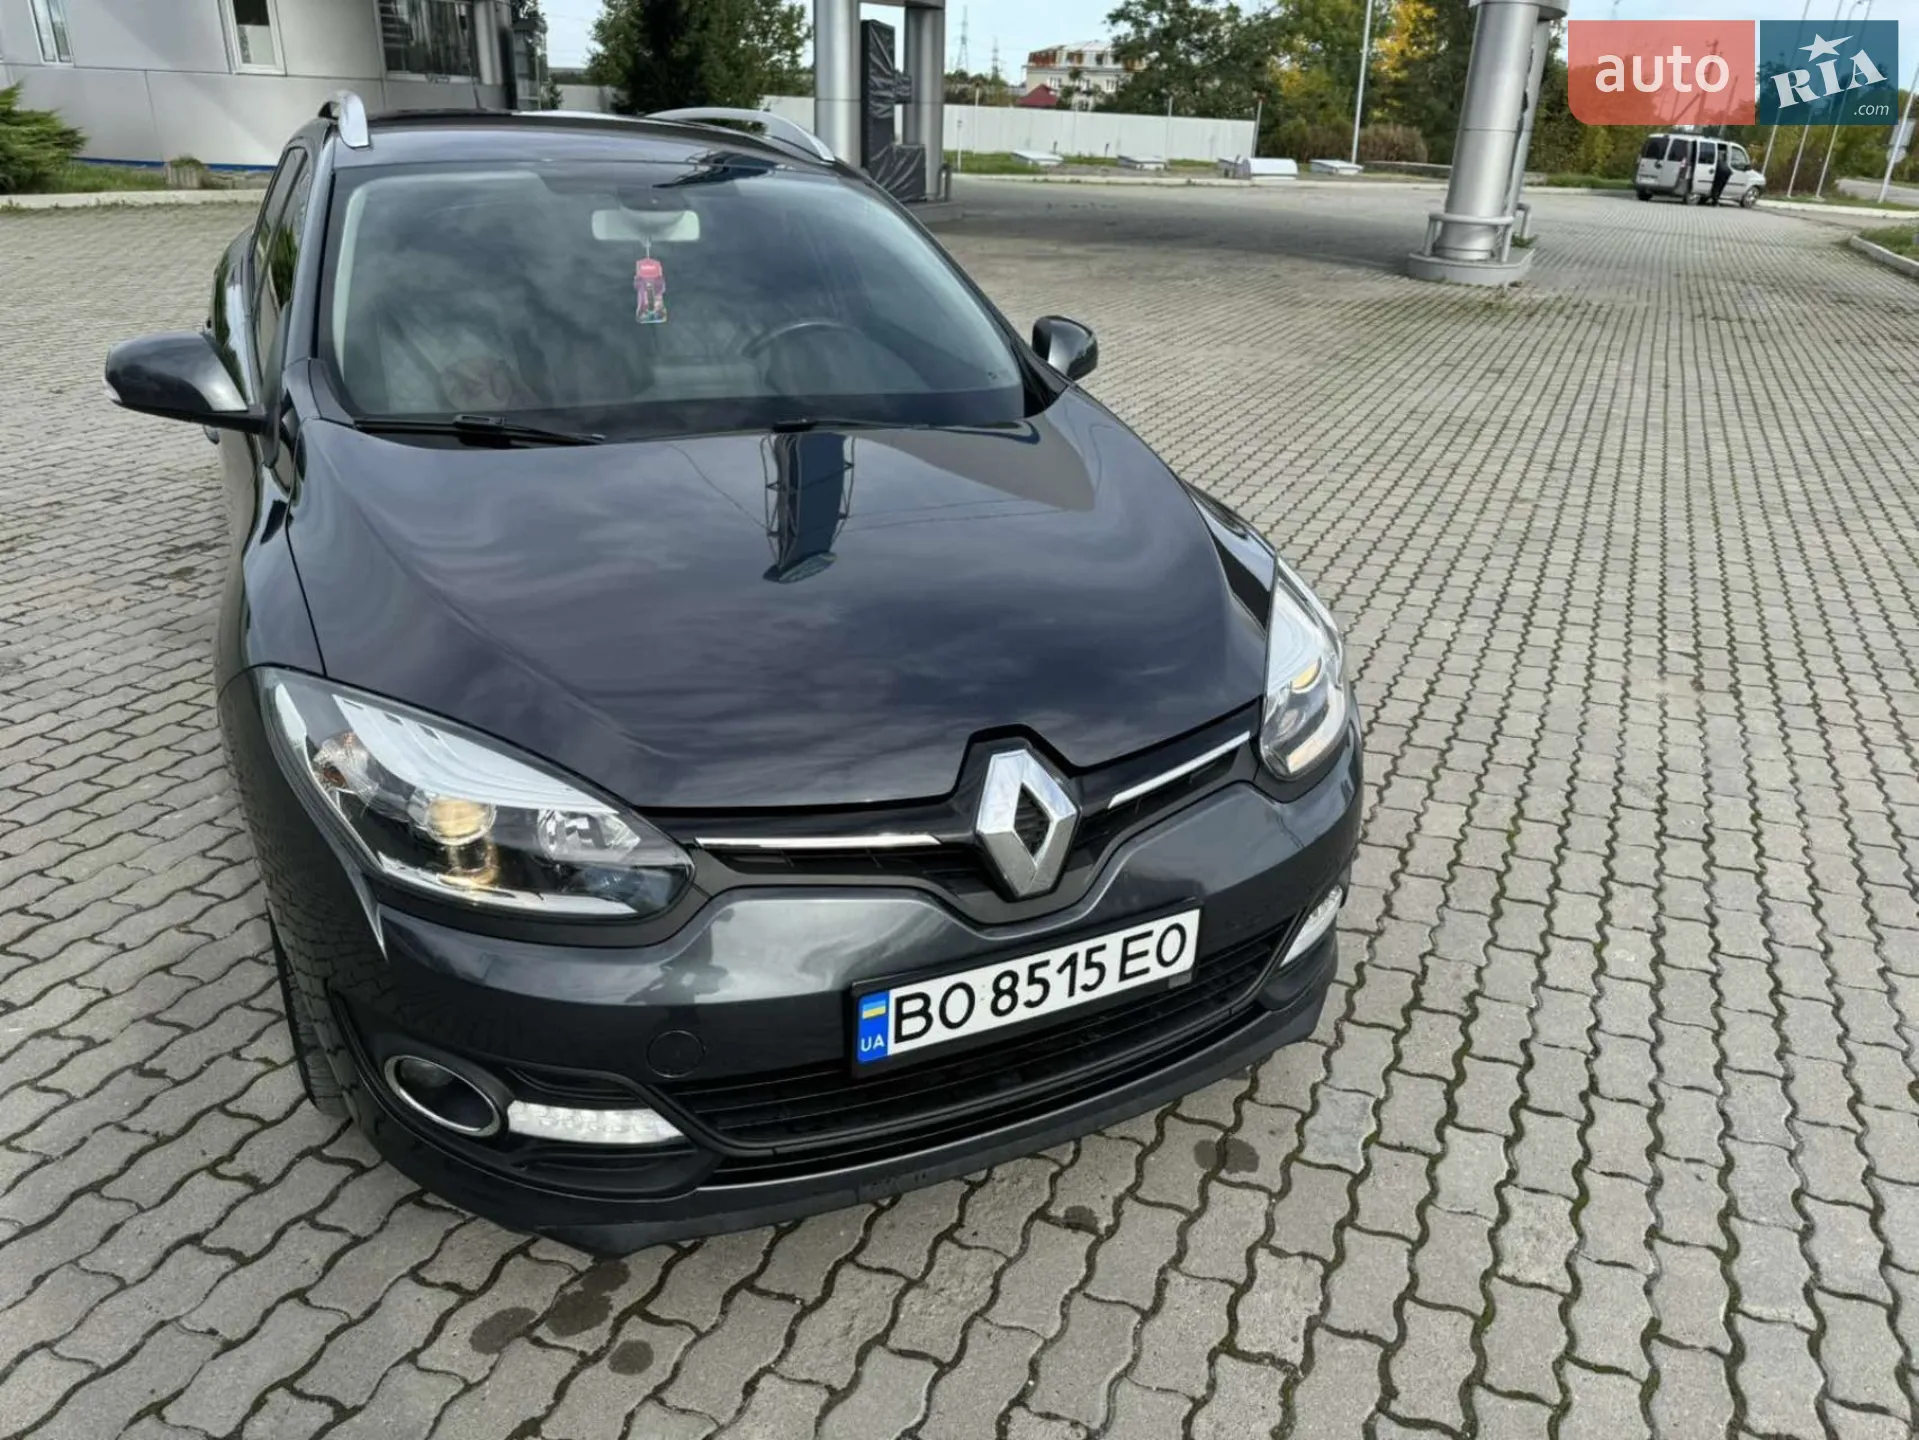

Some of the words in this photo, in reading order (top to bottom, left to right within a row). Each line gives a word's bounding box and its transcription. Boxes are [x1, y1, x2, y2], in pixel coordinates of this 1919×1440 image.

[893, 981, 977, 1045] BO
[990, 943, 1108, 1018] 8515
[1117, 922, 1188, 984] EO
[860, 1033, 886, 1052] UA
